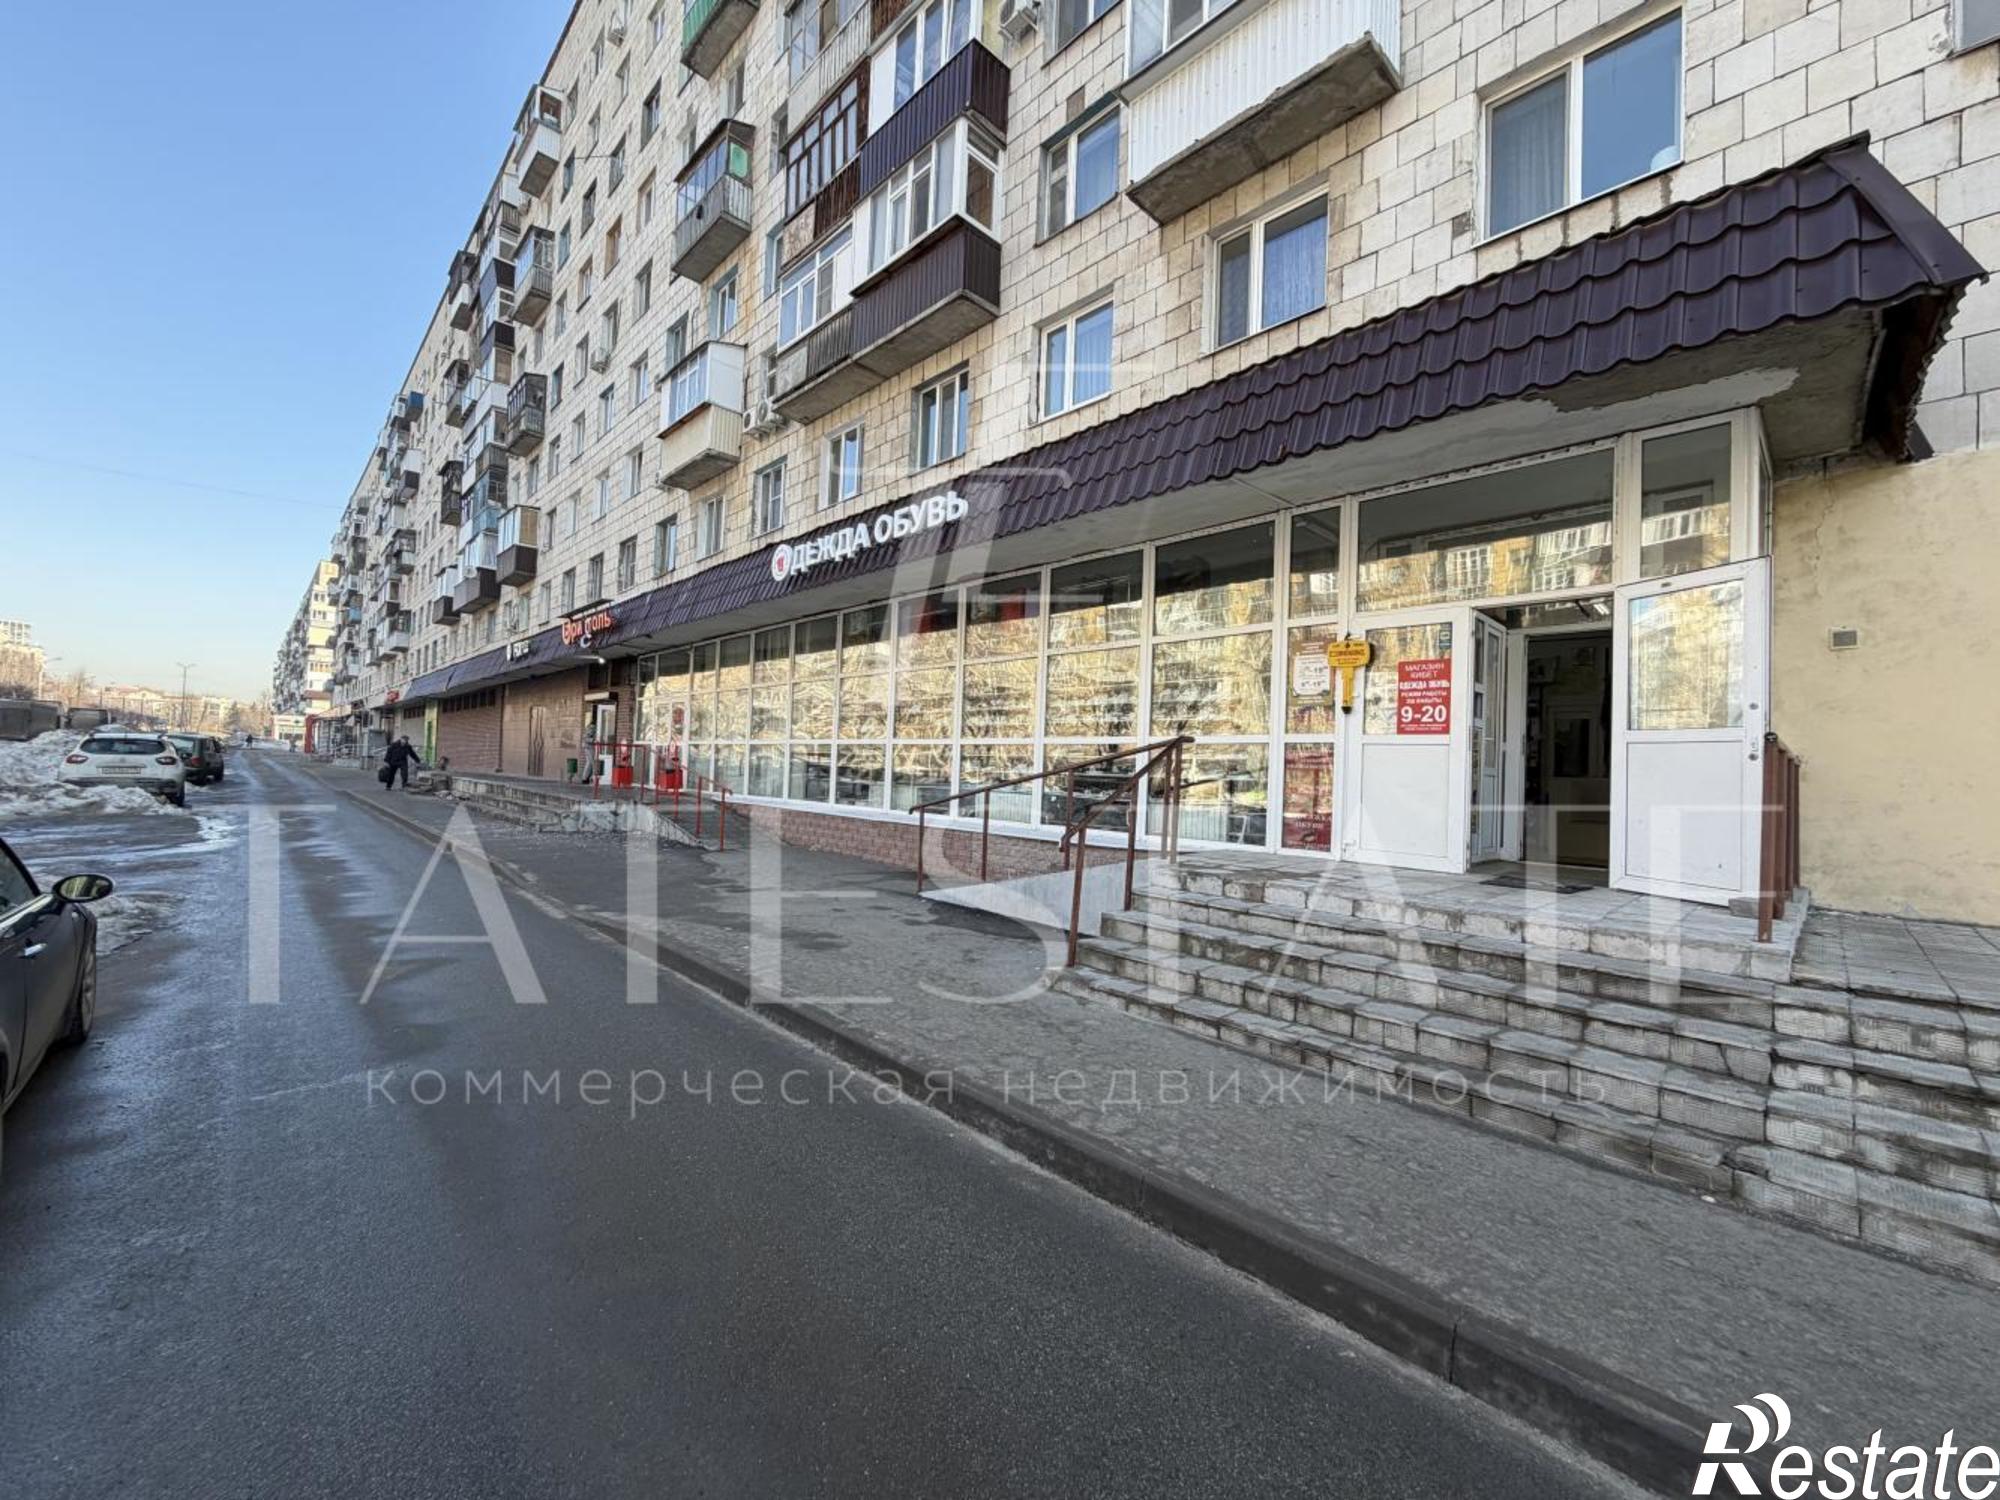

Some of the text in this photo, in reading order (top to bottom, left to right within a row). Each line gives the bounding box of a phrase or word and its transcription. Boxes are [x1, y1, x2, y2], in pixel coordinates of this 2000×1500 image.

[772, 491, 969, 581] ОДЕЖДА ОБУВЬ
[1401, 705, 1447, 722] 9-20
